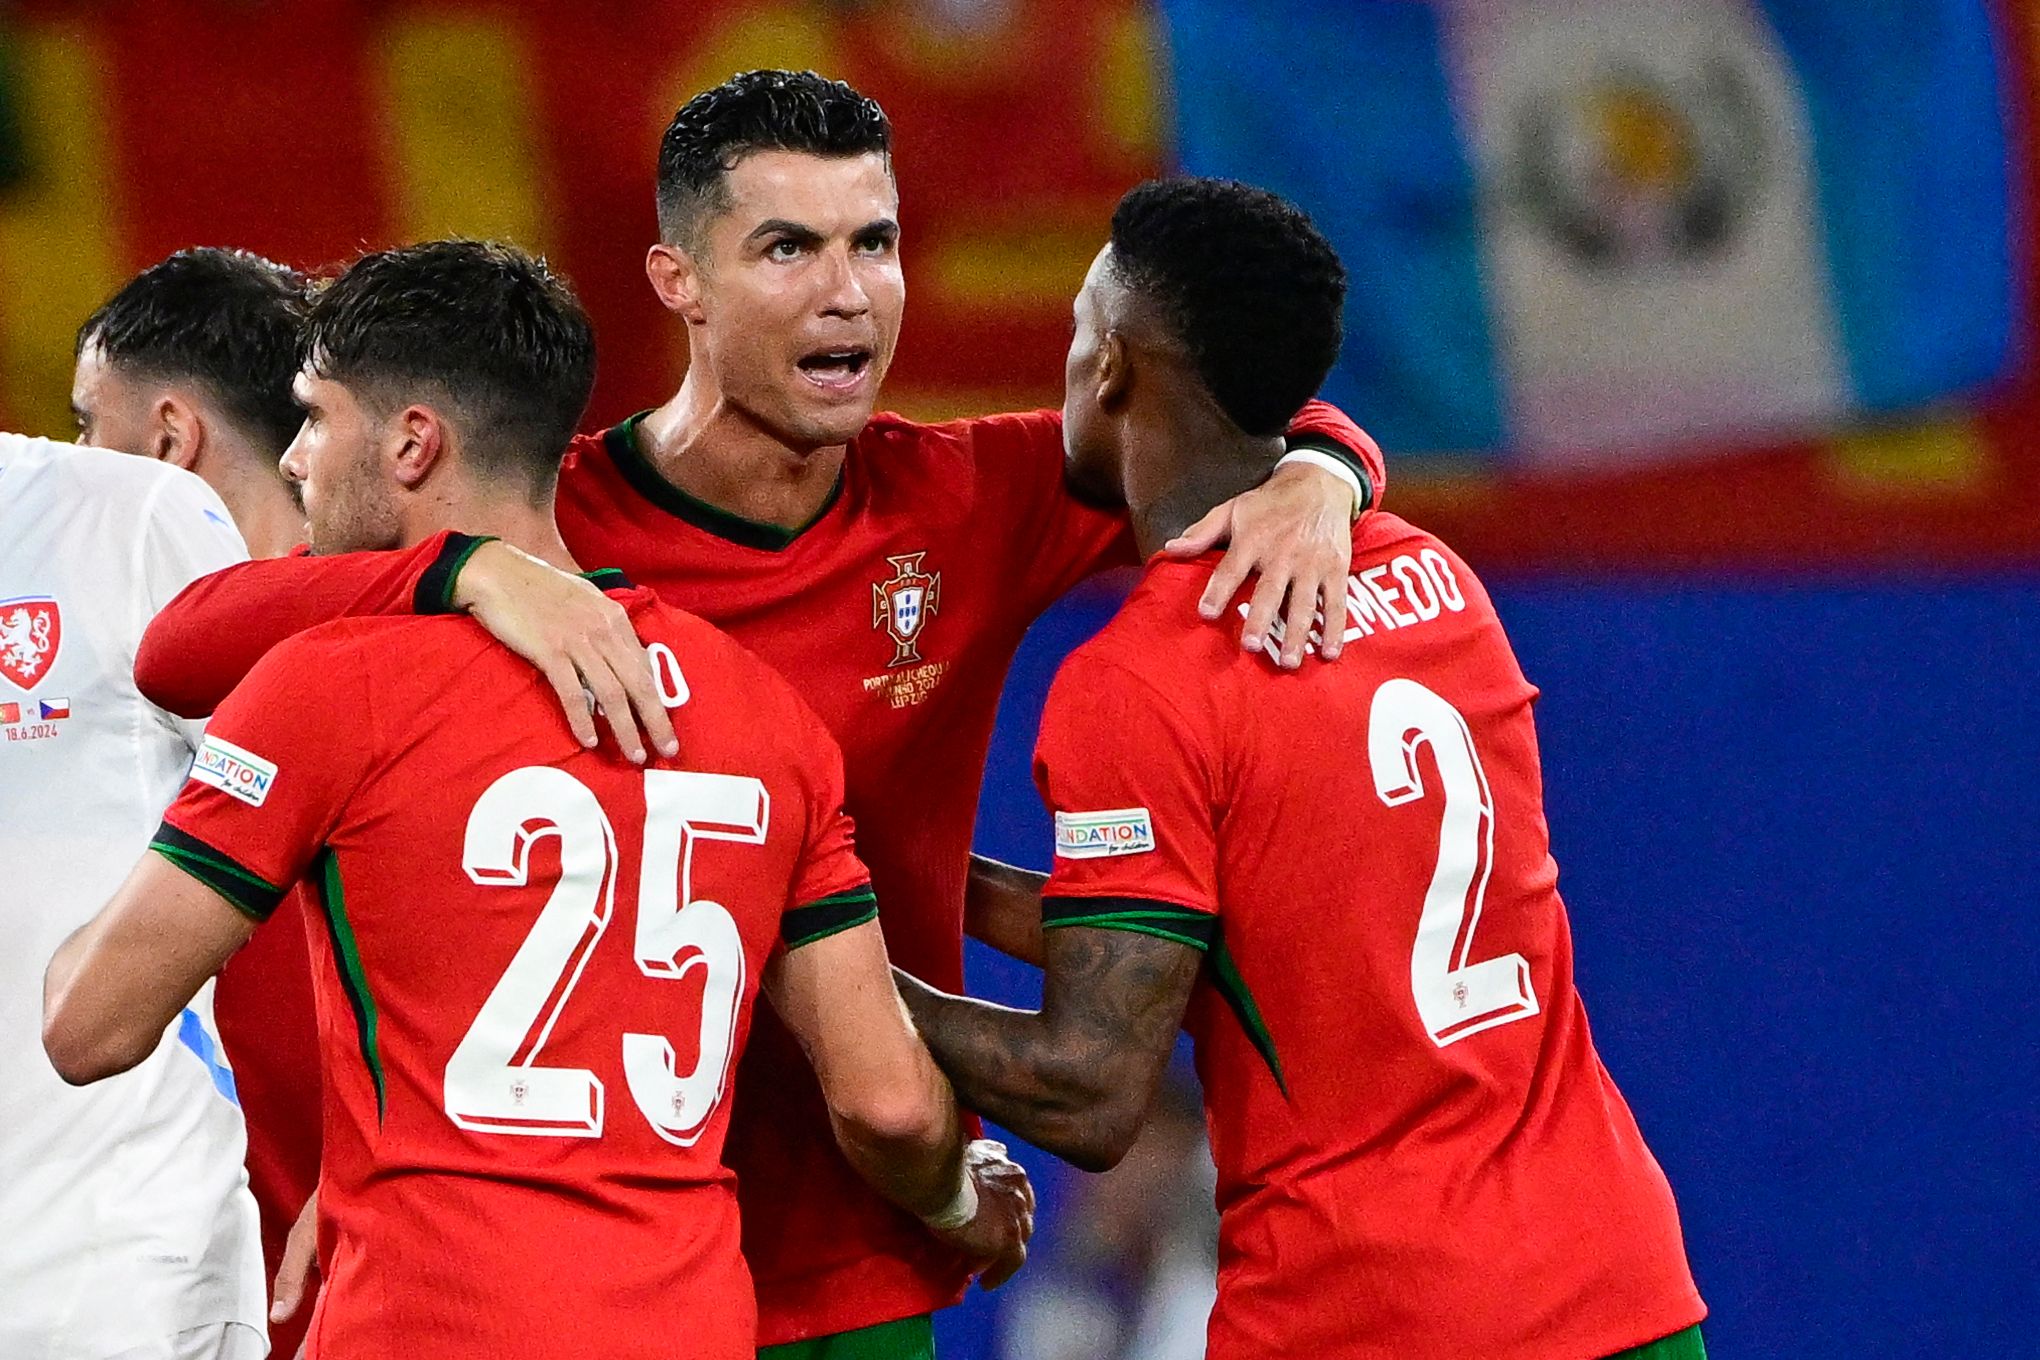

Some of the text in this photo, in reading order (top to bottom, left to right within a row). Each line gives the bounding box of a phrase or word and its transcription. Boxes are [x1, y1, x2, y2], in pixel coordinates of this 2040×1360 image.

[891, 691, 928, 709] LEIPZIG
[6, 724, 58, 741] 18.6.2024
[197, 749, 268, 791] UNDATION
[1060, 824, 1147, 843] UNDATION
[1368, 678, 1540, 1048] 2
[444, 766, 770, 1147] 25
